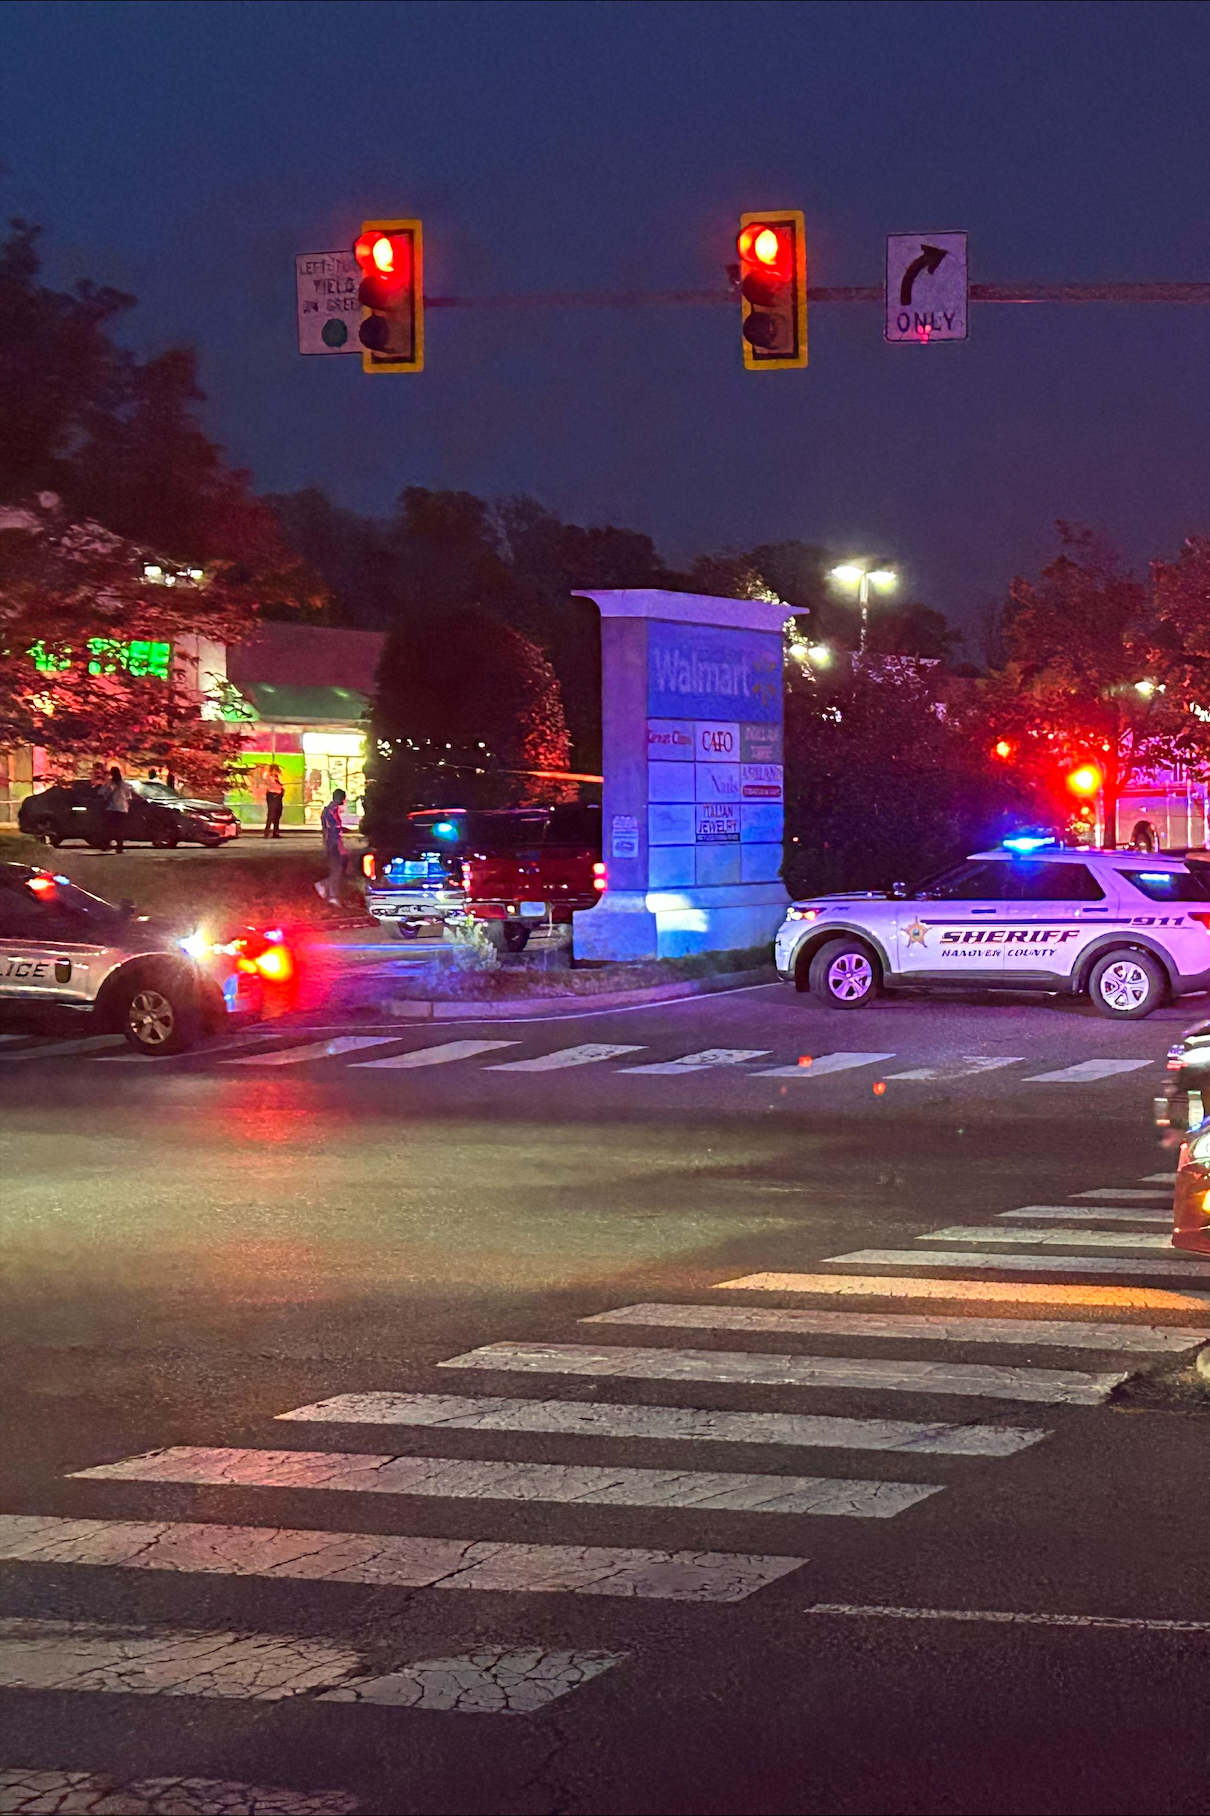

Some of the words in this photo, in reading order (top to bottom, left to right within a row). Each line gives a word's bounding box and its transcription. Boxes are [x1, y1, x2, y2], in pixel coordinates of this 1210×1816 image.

[897, 312, 956, 333] ONLY
[655, 648, 751, 697] Walmart
[702, 730, 733, 753] CATO
[1131, 916, 1186, 926] 911
[940, 930, 1080, 944] SHERIFF
[1007, 948, 1057, 957] COUNTY
[0, 962, 50, 978] ICE
